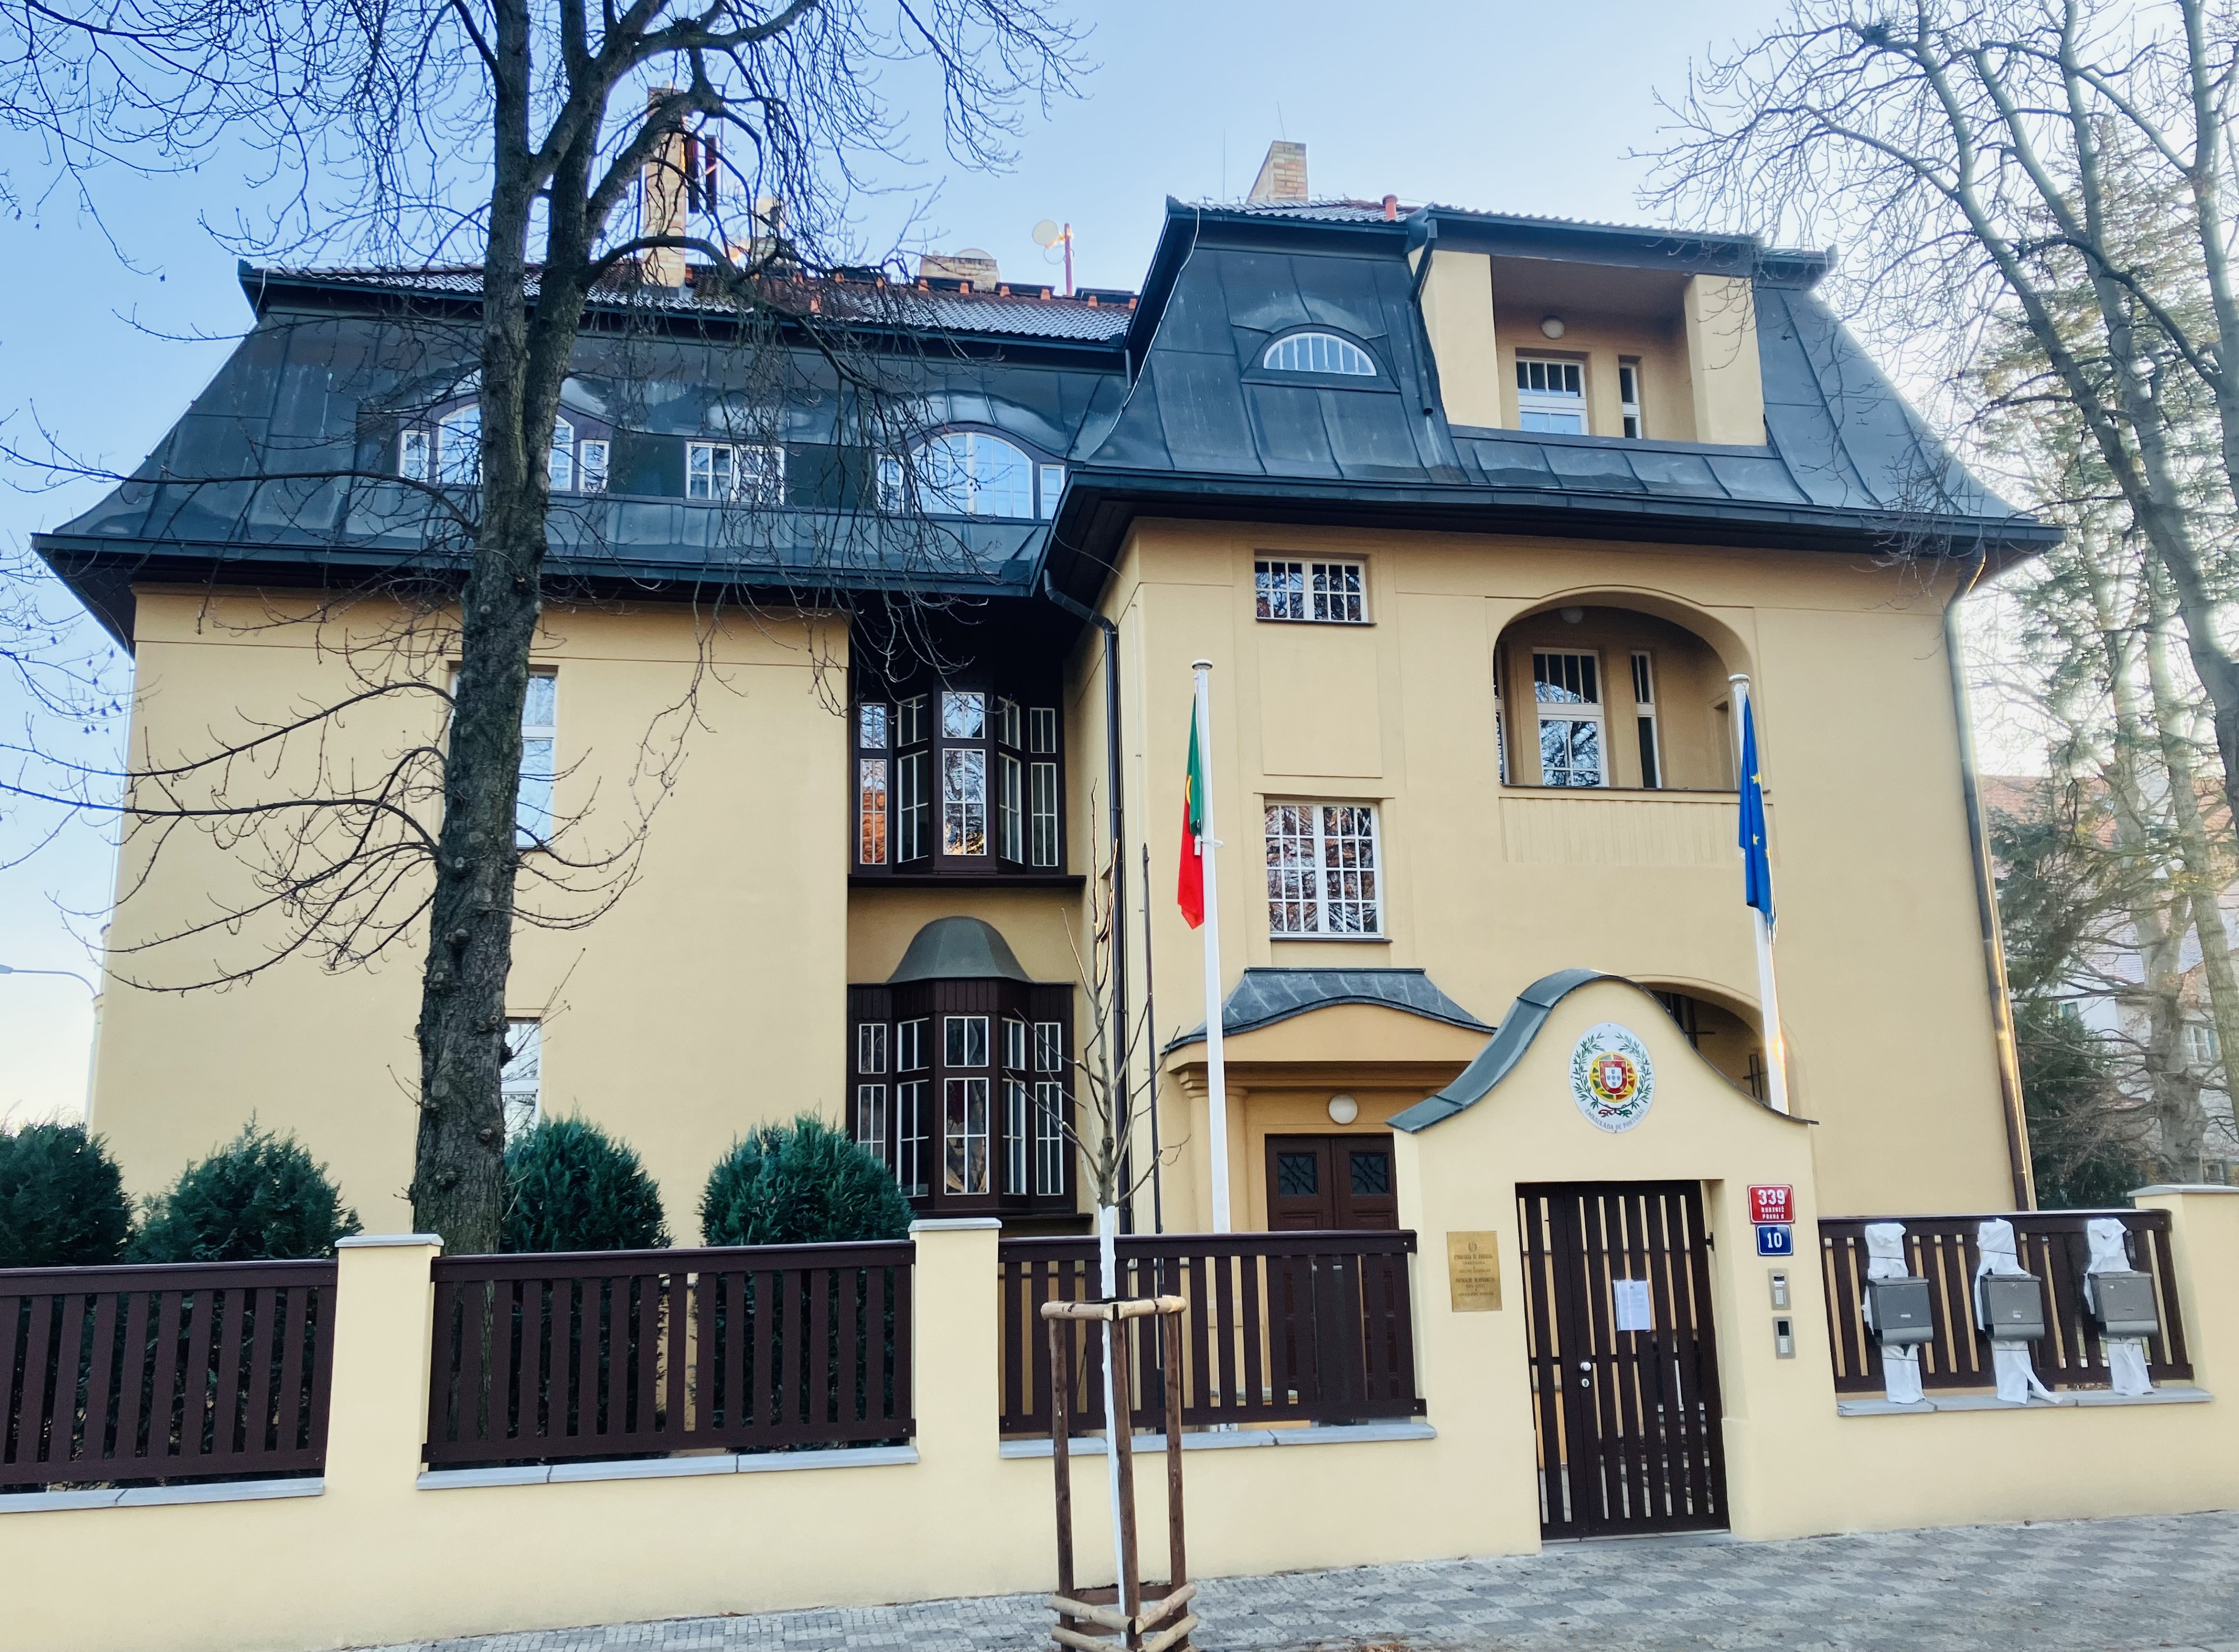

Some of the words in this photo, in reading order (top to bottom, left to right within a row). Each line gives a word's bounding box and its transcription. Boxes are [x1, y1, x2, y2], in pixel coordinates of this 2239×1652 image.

[1585, 1108, 1614, 1130] EMBAIXADA
[1623, 1109, 1645, 1129] PORTUGAL
[1758, 1189, 1786, 1206] 339
[1767, 1232, 1783, 1249] 10
